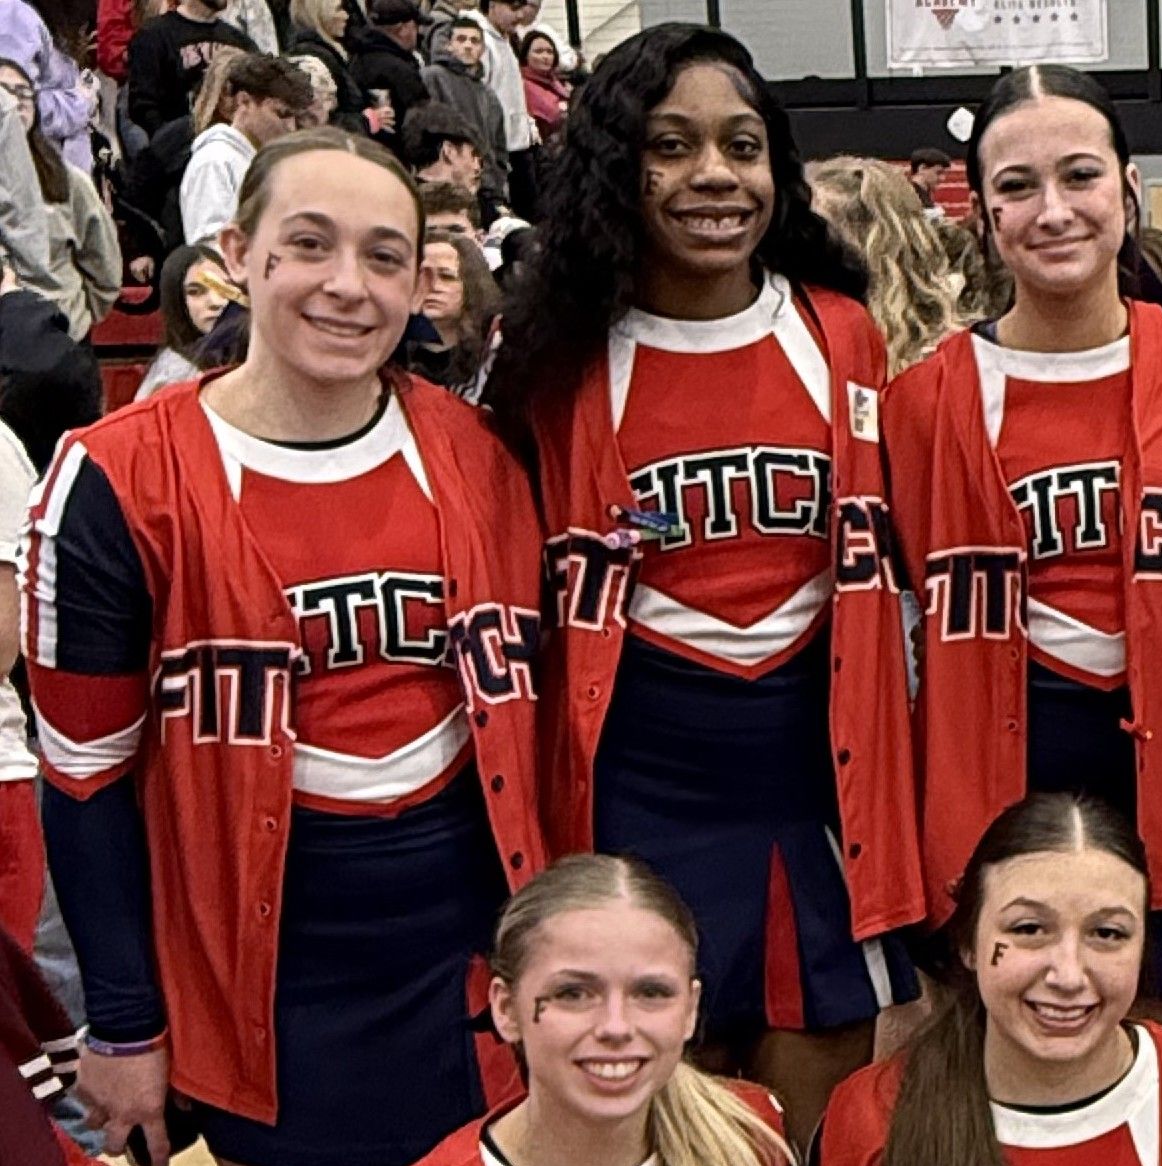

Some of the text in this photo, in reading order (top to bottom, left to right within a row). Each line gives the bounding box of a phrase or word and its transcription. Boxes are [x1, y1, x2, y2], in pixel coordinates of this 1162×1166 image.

[264, 251, 282, 281] F
[628, 446, 833, 552] ITC
[990, 941, 1010, 967] F
